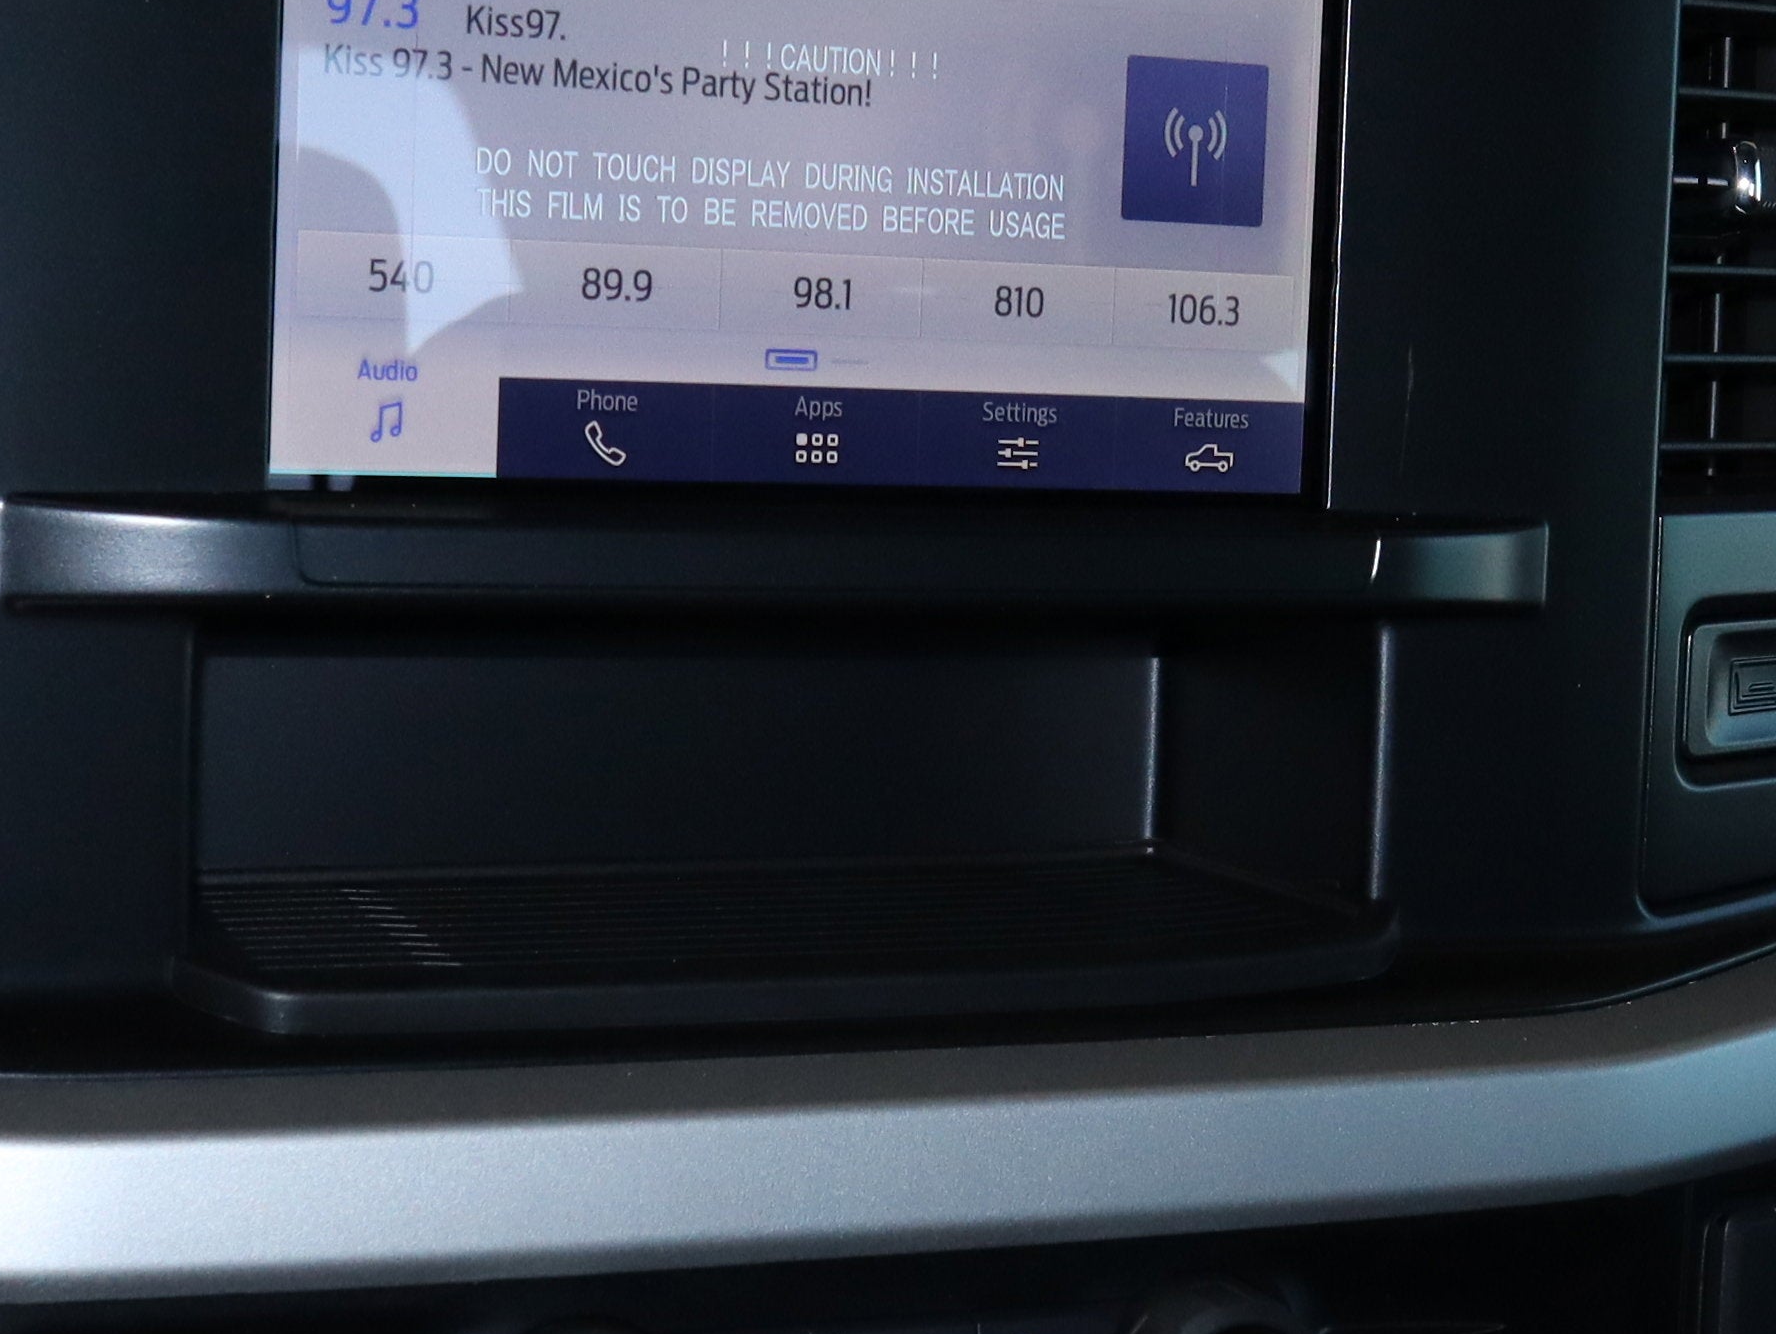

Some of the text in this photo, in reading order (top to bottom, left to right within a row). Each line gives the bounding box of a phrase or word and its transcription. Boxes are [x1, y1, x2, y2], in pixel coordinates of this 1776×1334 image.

[466, 5, 566, 41] Kiss97.
[324, 45, 383, 77] Kiss
[393, 47, 453, 81] 97.3
[481, 54, 545, 86] New
[553, 60, 673, 94] Mexico's
[682, 67, 755, 103] Party
[764, 73, 872, 107] Station!
[476, 147, 1064, 201] DO NOT TOUCH DISPLAY DURING INSTALLATION
[476, 188, 1065, 240] THIS FILM IS TO BE REMOVED BEFORE USAGE
[368, 259, 434, 294] 540
[582, 268, 653, 302] 89.9
[794, 277, 852, 310] 98.1
[994, 287, 1044, 317] 810
[1168, 294, 1240, 326] 106.3
[358, 358, 418, 382] Audio
[577, 389, 638, 412] Phone
[794, 396, 842, 418] Apps
[983, 402, 1057, 425] Settings
[1173, 408, 1249, 430] Features
